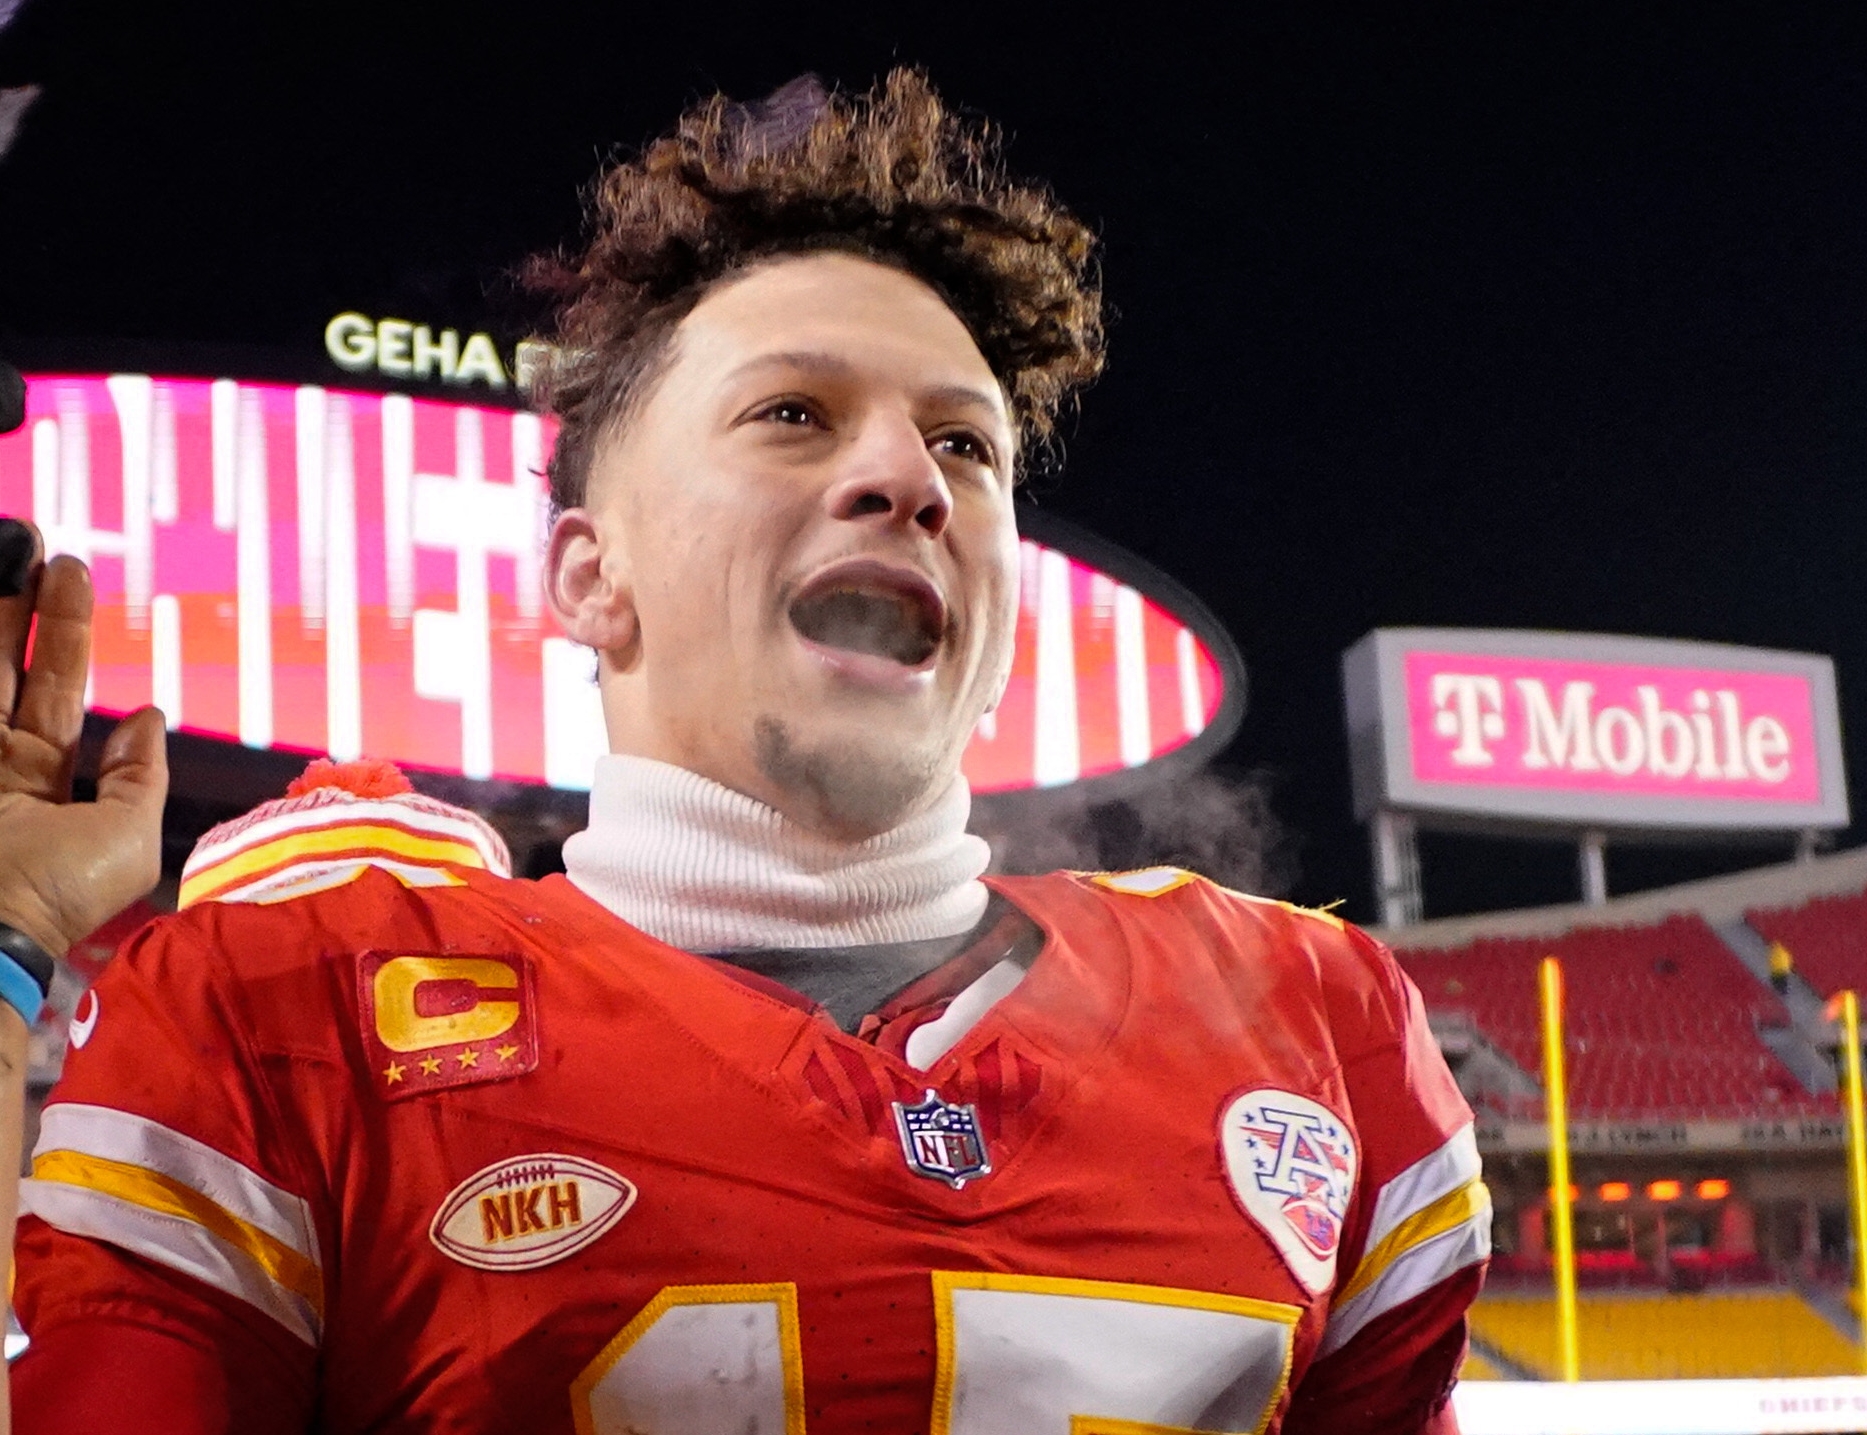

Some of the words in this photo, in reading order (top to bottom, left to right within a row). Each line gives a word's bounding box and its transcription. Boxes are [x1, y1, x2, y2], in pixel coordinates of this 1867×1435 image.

[325, 311, 507, 390] GEHA
[1515, 677, 1792, 783] Mobile
[373, 955, 521, 1054] C
[914, 1133, 979, 1171] NFL
[478, 1180, 584, 1245] NKH
